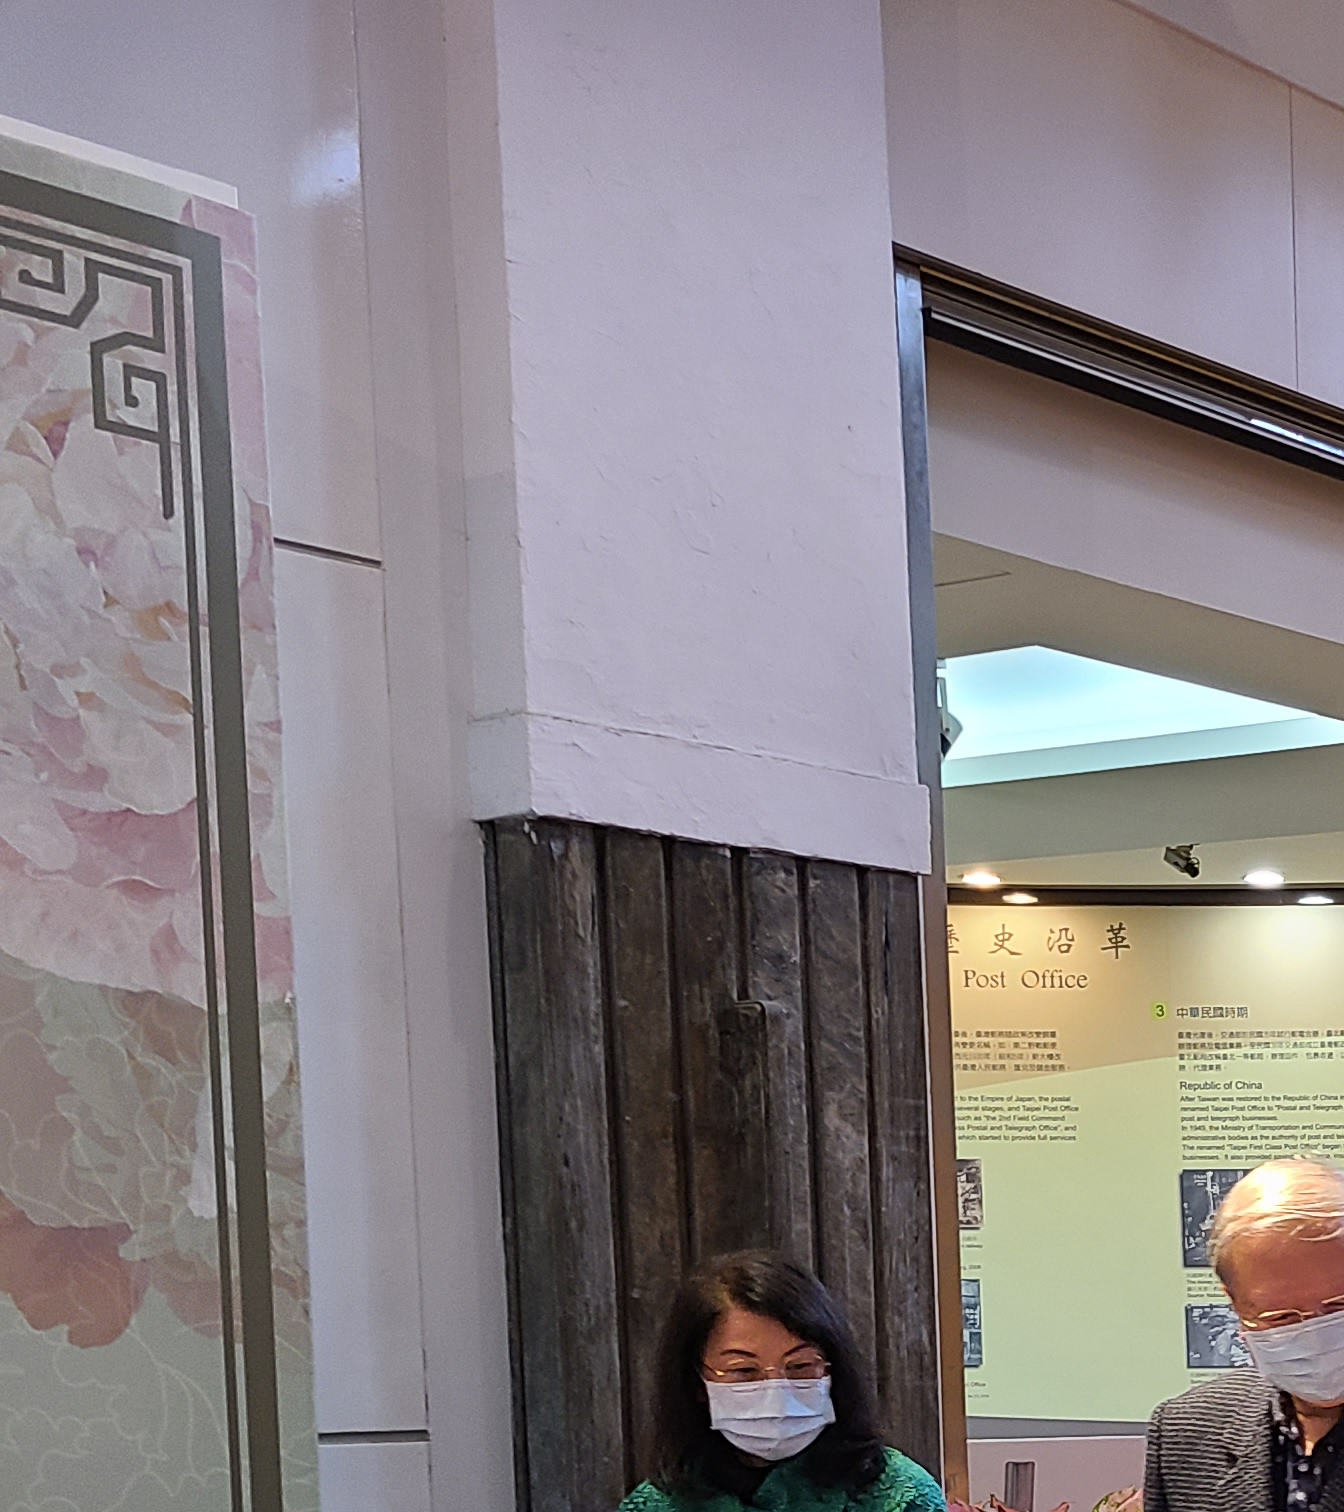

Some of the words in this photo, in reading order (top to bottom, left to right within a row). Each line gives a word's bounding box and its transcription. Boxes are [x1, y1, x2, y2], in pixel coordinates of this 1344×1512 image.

[963, 970, 1007, 988] Post
[1021, 969, 1088, 988] Office
[1155, 1004, 1165, 1018] 3
[1176, 1006, 1249, 1019] 中華民國時期
[1179, 1081, 1221, 1090] Republic
[1223, 1081, 1233, 1090] of
[1234, 1081, 1263, 1089] China
